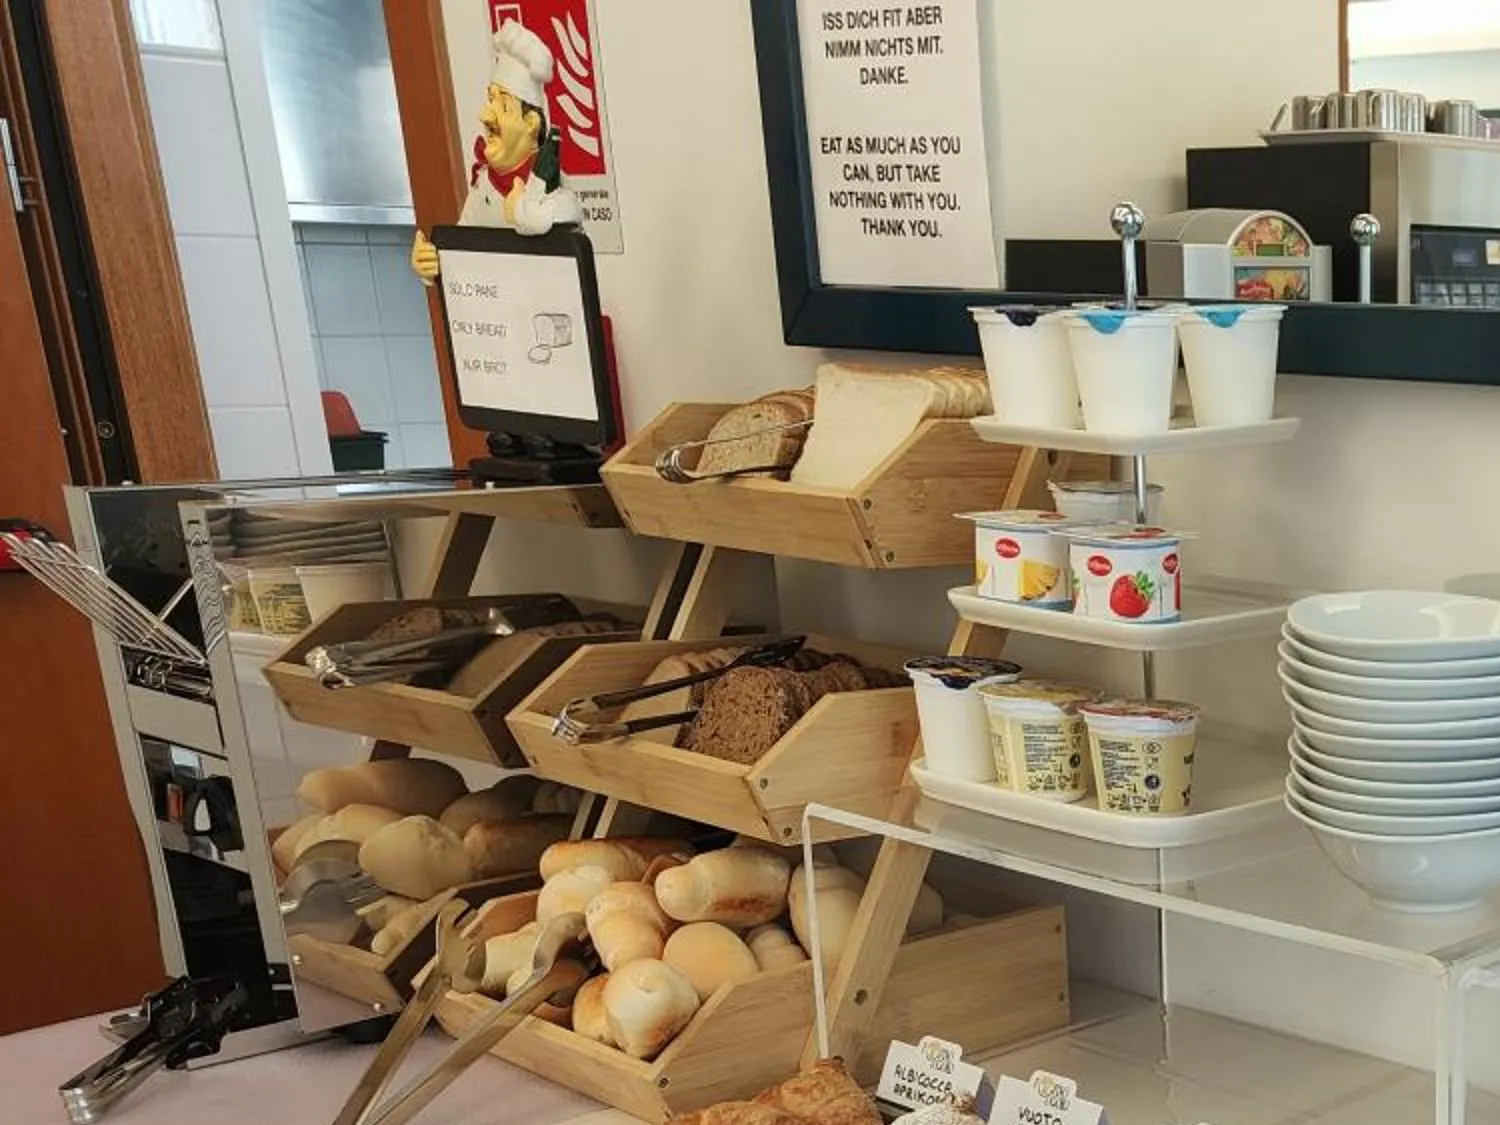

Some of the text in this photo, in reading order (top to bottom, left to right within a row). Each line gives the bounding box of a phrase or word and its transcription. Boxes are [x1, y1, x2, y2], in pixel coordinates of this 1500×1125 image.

[822, 6, 943, 30] ISS DICH FIT ABER
[825, 36, 944, 59] NIMM NICHTS MIT.
[860, 66, 909, 85] DANKE.
[821, 136, 961, 155] EAT AS MUCH AS YOU
[843, 164, 941, 183] CAN, BUT TAKE
[829, 191, 961, 211] NOTHING WITH YOU.
[861, 218, 943, 238] THANK YOU.
